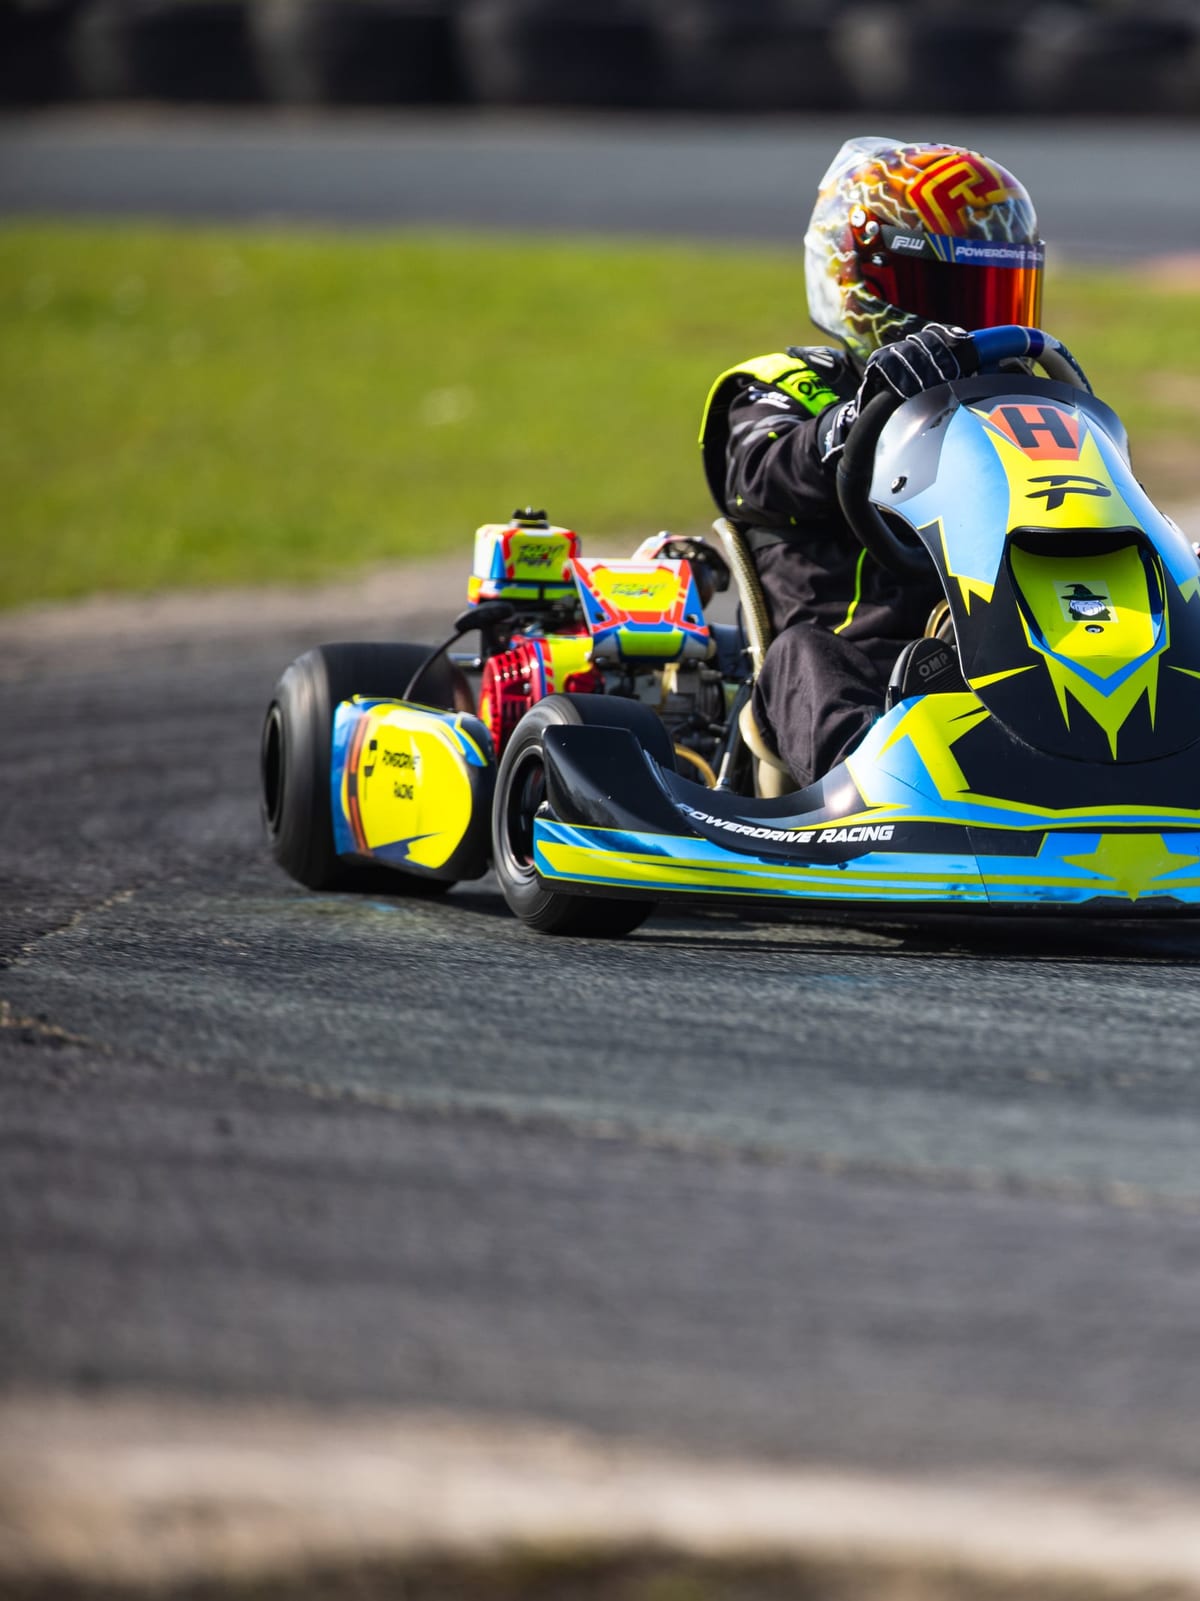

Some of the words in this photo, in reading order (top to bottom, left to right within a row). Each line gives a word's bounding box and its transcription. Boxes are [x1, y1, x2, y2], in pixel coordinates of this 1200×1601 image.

[955, 246, 1025, 259] POWERDRIVE
[1001, 407, 1076, 449] H
[919, 652, 948, 677] OMP
[676, 802, 815, 843] POWERDRIVE
[817, 825, 895, 844] RACING
